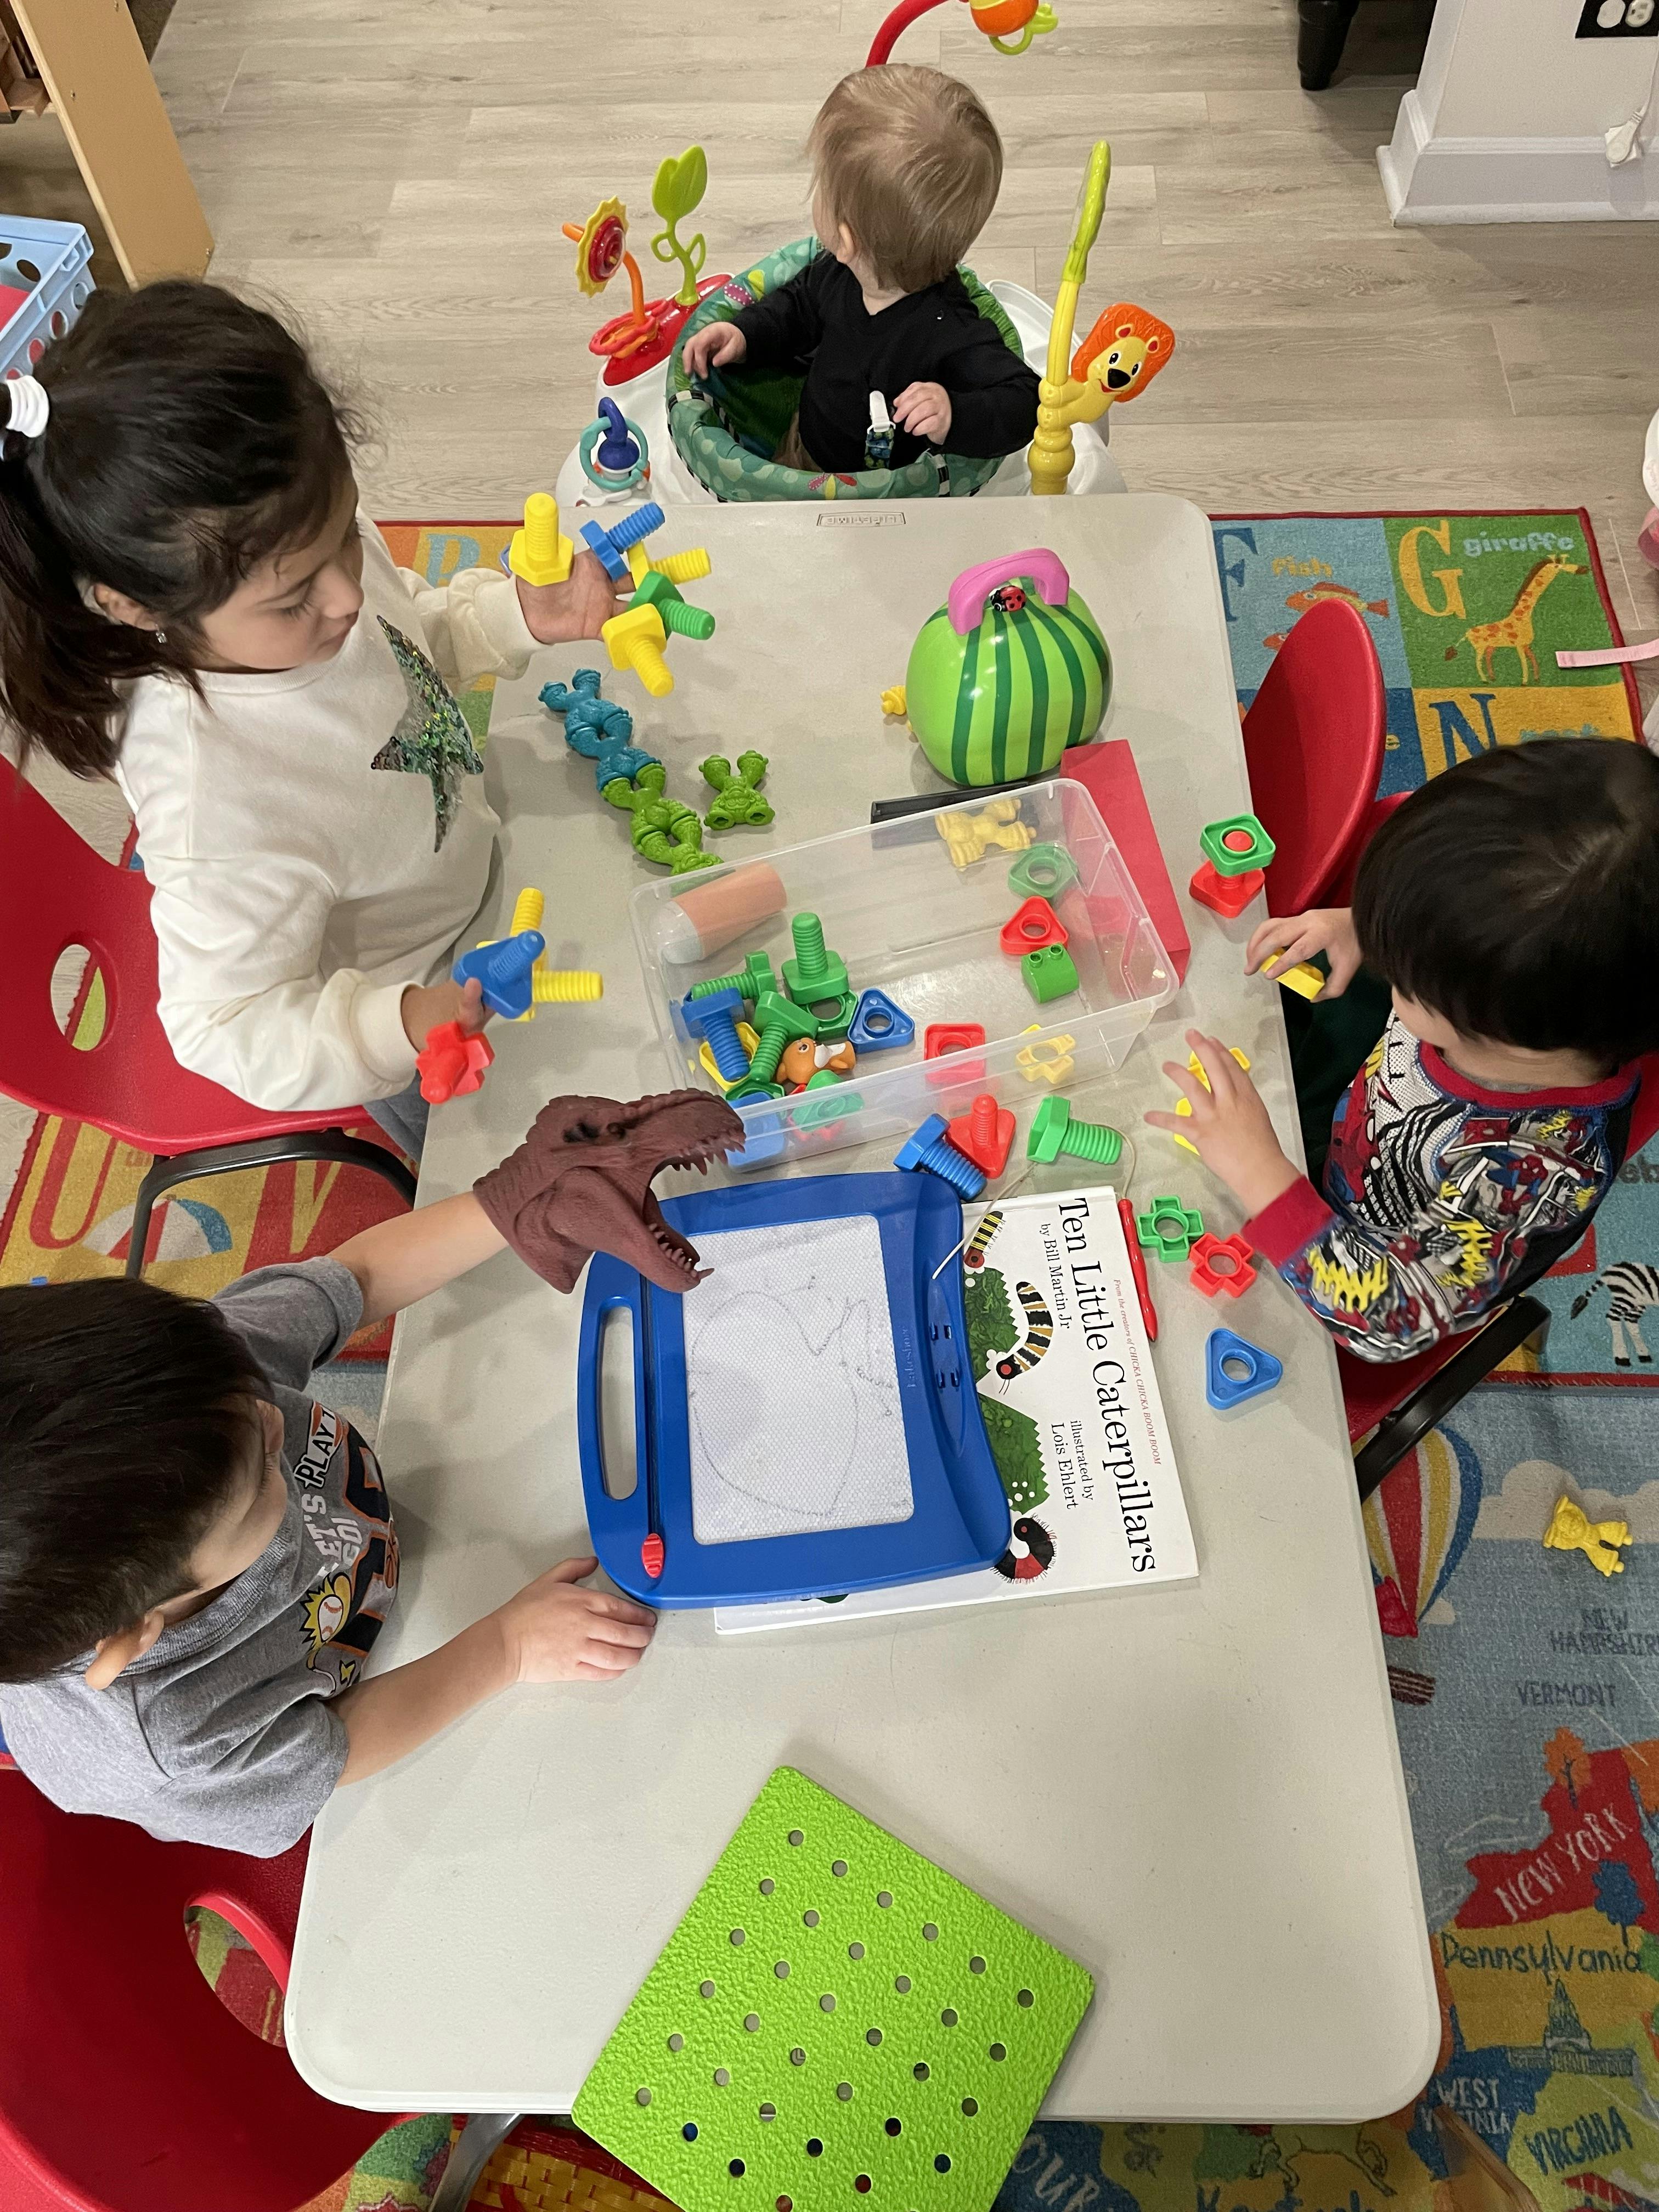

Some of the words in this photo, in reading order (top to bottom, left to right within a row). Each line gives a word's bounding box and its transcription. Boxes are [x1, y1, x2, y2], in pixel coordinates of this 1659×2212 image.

[1464, 531, 1575, 558] giraffe
[1214, 527, 1259, 621] F
[1398, 520, 1466, 619] G
[1429, 693, 1497, 768] N
[1040, 1223, 1051, 1237] by
[1058, 1198, 1090, 1254] Ten
[1043, 1239, 1060, 1262] Bill
[1049, 1265, 1067, 1311] Martin
[1114, 1279, 1122, 1297] From
[1058, 1314, 1072, 1329] Jr
[1071, 1260, 1114, 1351] Little
[1120, 1310, 1131, 1337] creators
[1127, 1338, 1135, 1346] of
[1128, 1346, 1141, 1378] CHICKA
[1136, 1379, 1149, 1411] CHICKA
[1143, 1412, 1155, 1437] BOOM
[295, 1423, 335, 1485] PLAY
[1051, 1423, 1065, 1455] Lois
[1058, 1459, 1079, 1510] Ehlert
[1070, 1420, 1093, 1482] illustrated
[1082, 1485, 1094, 1500] by
[1093, 1361, 1156, 1572] Caterpillars
[1149, 1437, 1161, 1465] BOOM
[331, 1517, 363, 1567] GO!
[1581, 1609, 1628, 1632] NEW
[1550, 1630, 1659, 1656] HAMPSHIR
[1517, 1681, 1616, 1708] VERMONT
[1555, 1802, 1633, 1874] YORK
[1440, 1932, 1644, 1985] Pennsylvania
[1436, 2077, 1499, 2108] WEST
[1524, 2107, 1633, 2175] VIRGINIA
